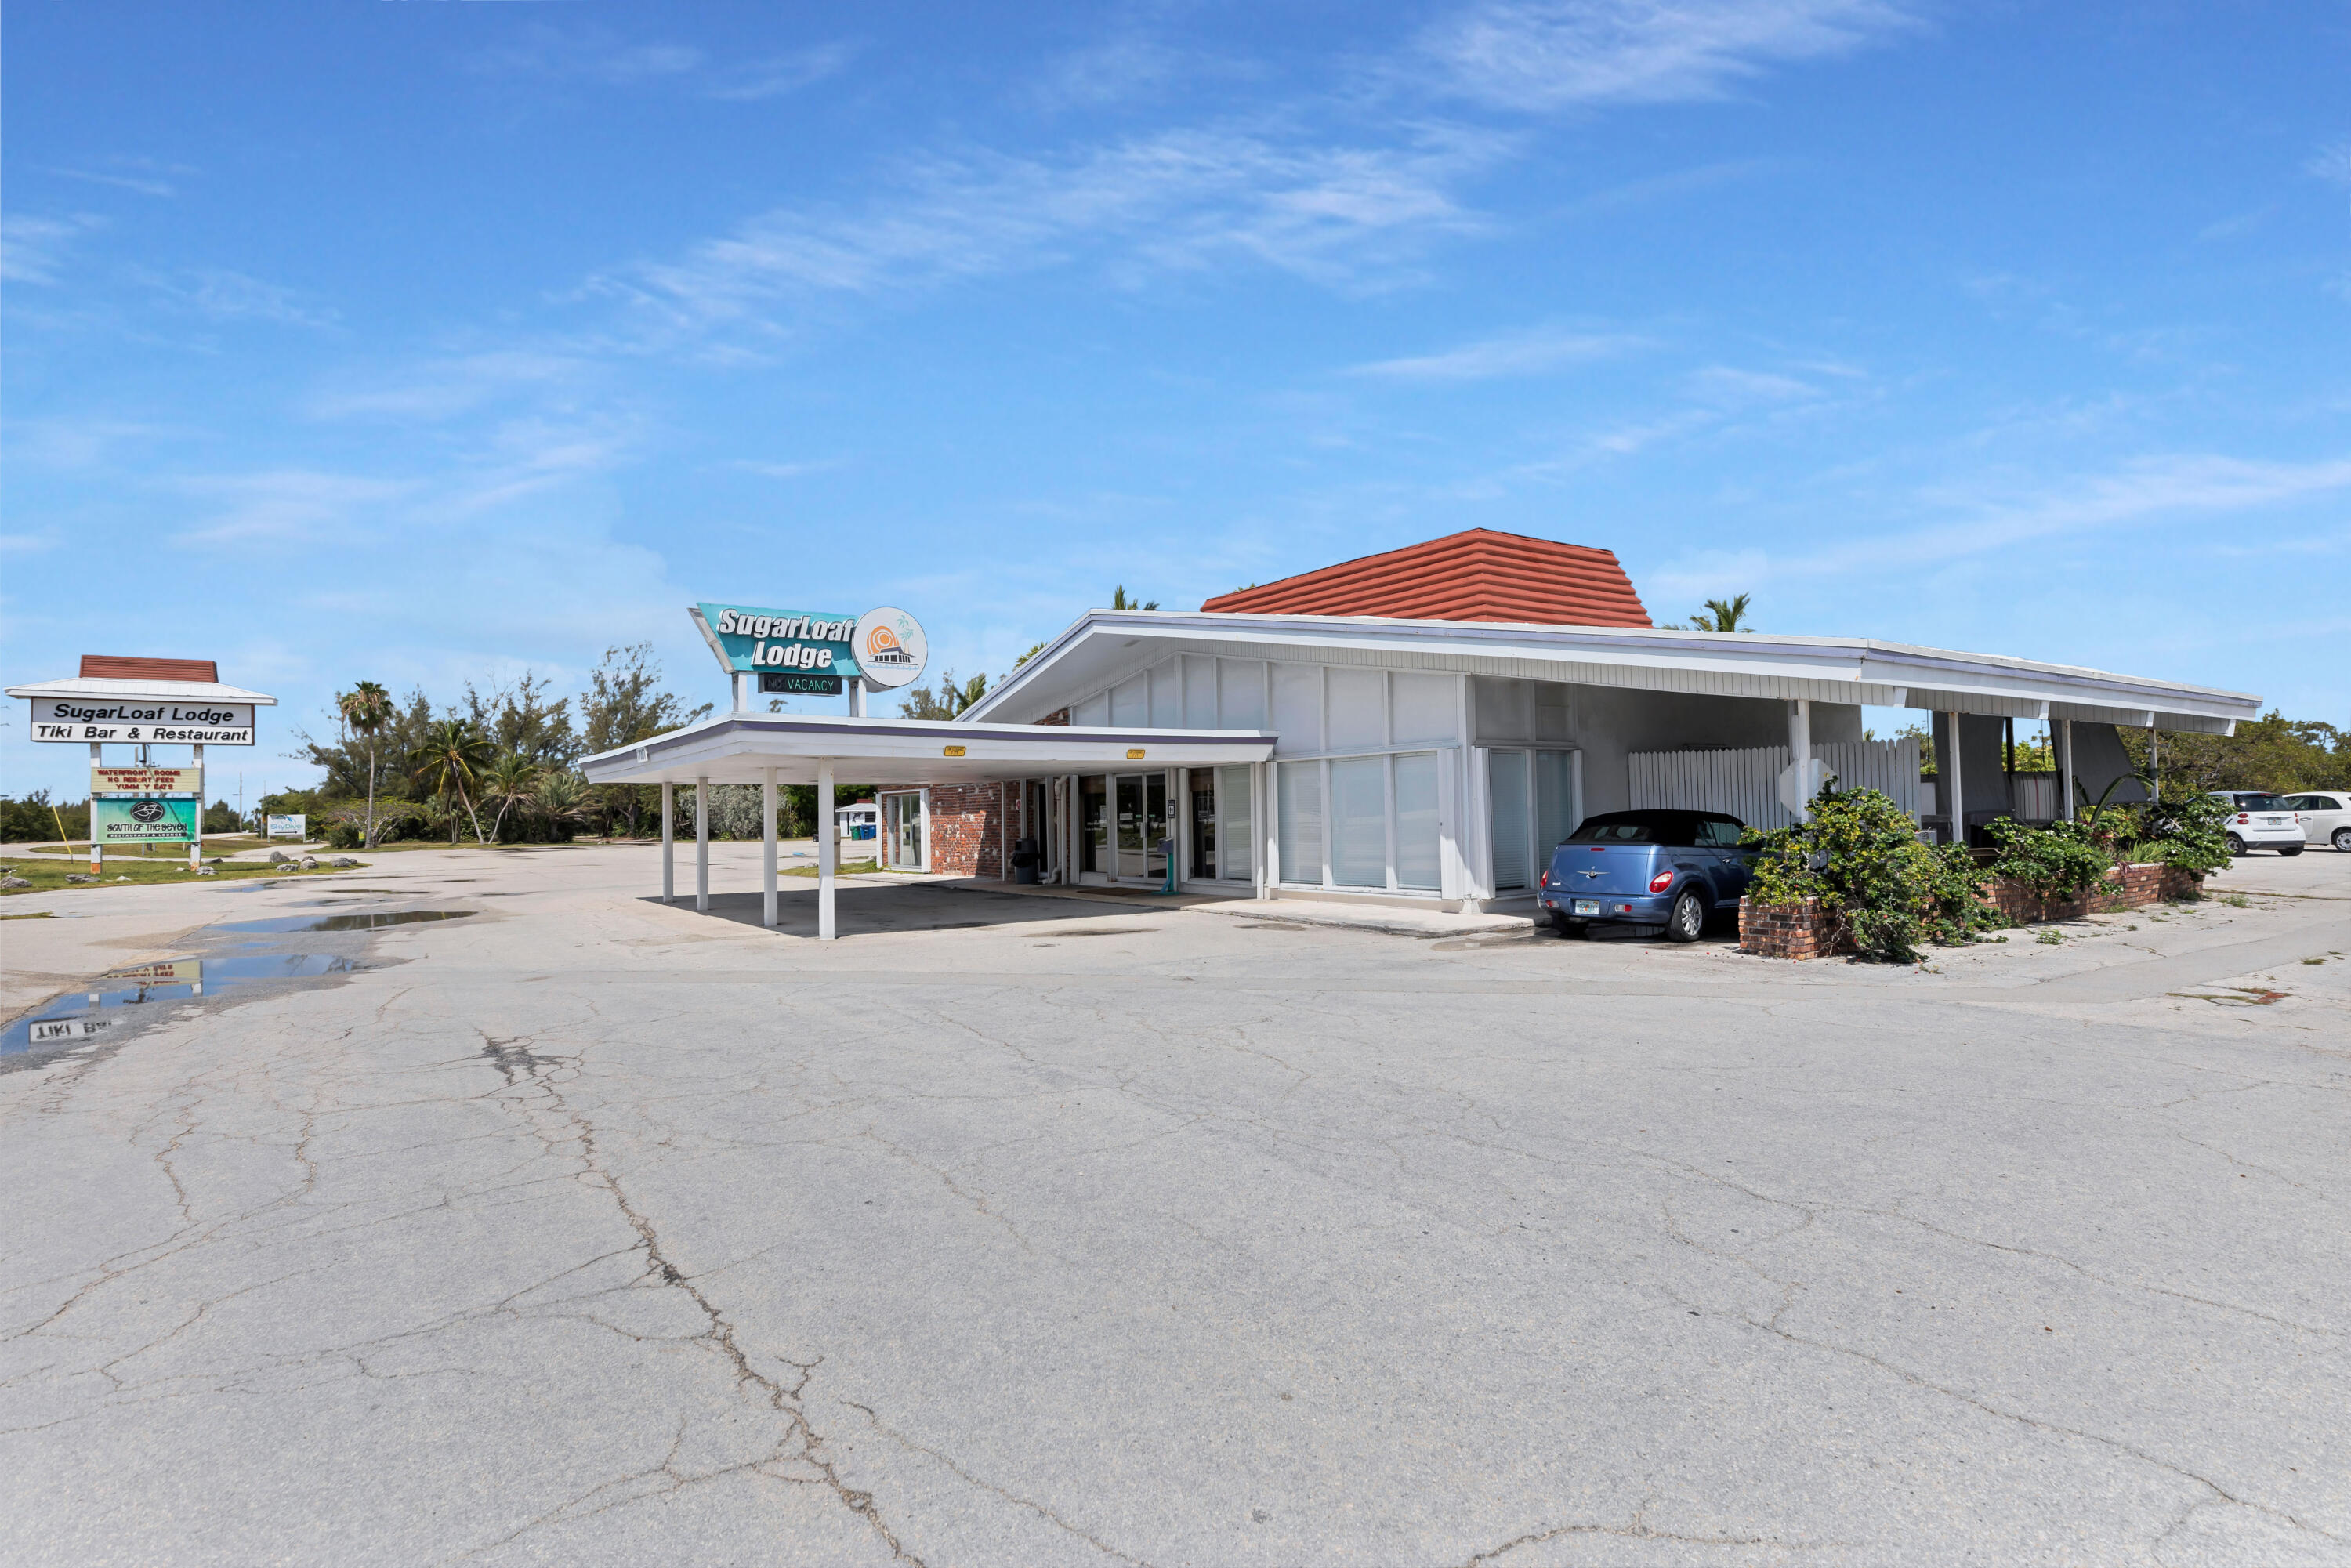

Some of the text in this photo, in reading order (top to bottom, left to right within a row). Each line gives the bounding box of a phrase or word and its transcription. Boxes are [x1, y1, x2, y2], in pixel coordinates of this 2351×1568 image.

[716, 608, 855, 642] SugarLoaf
[751, 641, 832, 670] Lodge
[787, 678, 834, 691] VACANCY
[53, 703, 234, 725] SugarLoaf Lodge
[38, 725, 248, 741] Tiki Bar & Restaurant
